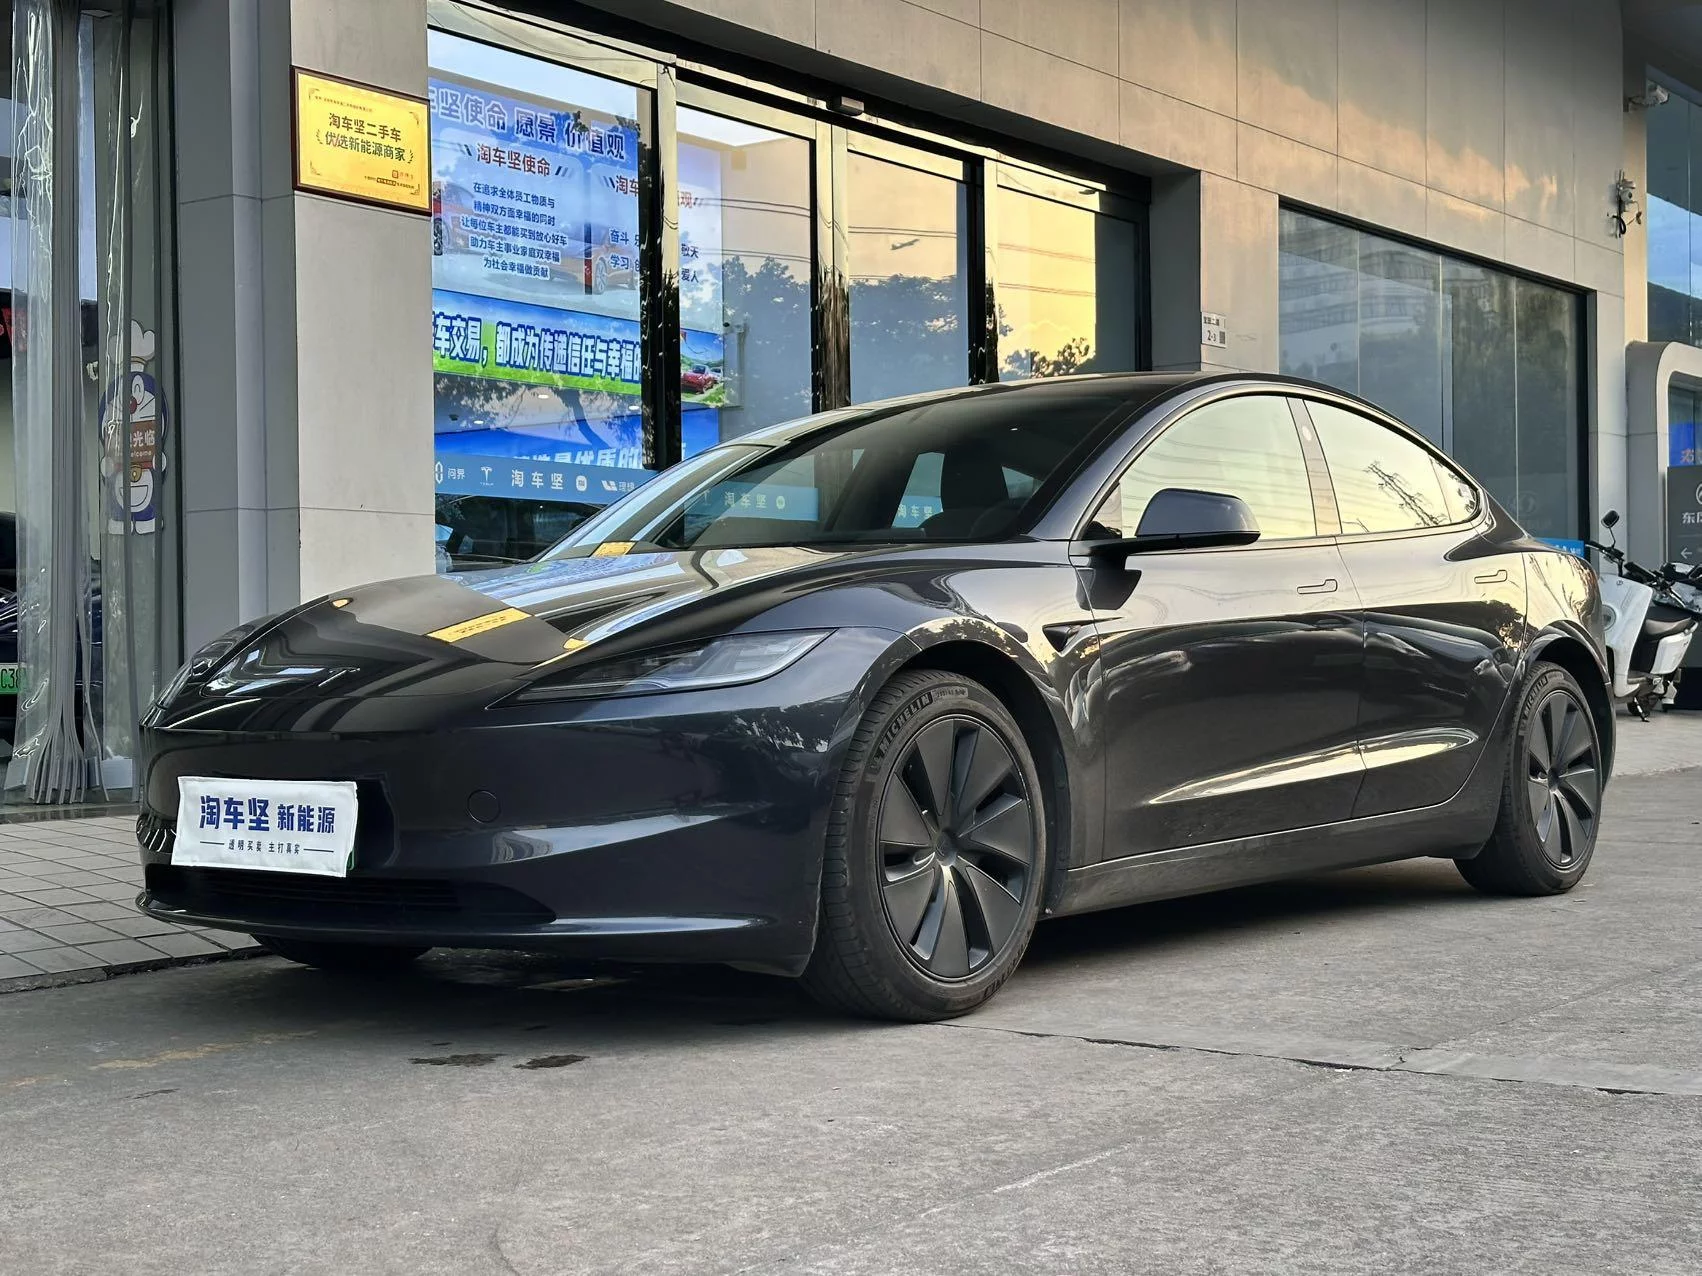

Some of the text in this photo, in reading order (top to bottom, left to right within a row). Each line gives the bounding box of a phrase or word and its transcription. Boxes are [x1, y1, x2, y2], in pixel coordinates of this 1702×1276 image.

[329, 112, 402, 143] 淘车坚二手车
[514, 107, 556, 144] 愿景
[564, 119, 625, 161] 价值观
[325, 131, 406, 162] 优选新能源商家
[476, 143, 551, 177] 淘车坚使命
[473, 182, 555, 209] 在追求全体员工物质与
[473, 200, 556, 227] 精神双方面幸福的同时
[461, 216, 568, 247] 让每位车主都能买到放心好车
[610, 228, 629, 245] 奋斗
[470, 235, 560, 263] 助力车主事业家庭双幸福
[610, 255, 629, 270] 学习
[680, 243, 700, 259] 敬天
[483, 257, 549, 278] 为社会幸福做贡献
[681, 267, 699, 283] 爱人
[447, 467, 466, 481] 问界
[511, 469, 564, 491] 淘车坚
[724, 491, 767, 508] 淘车坚
[877, 690, 934, 758] MICHELIN
[199, 795, 336, 834] 淘车坚 新能源
[228, 838, 301, 855] 透明买卖 主打真实
